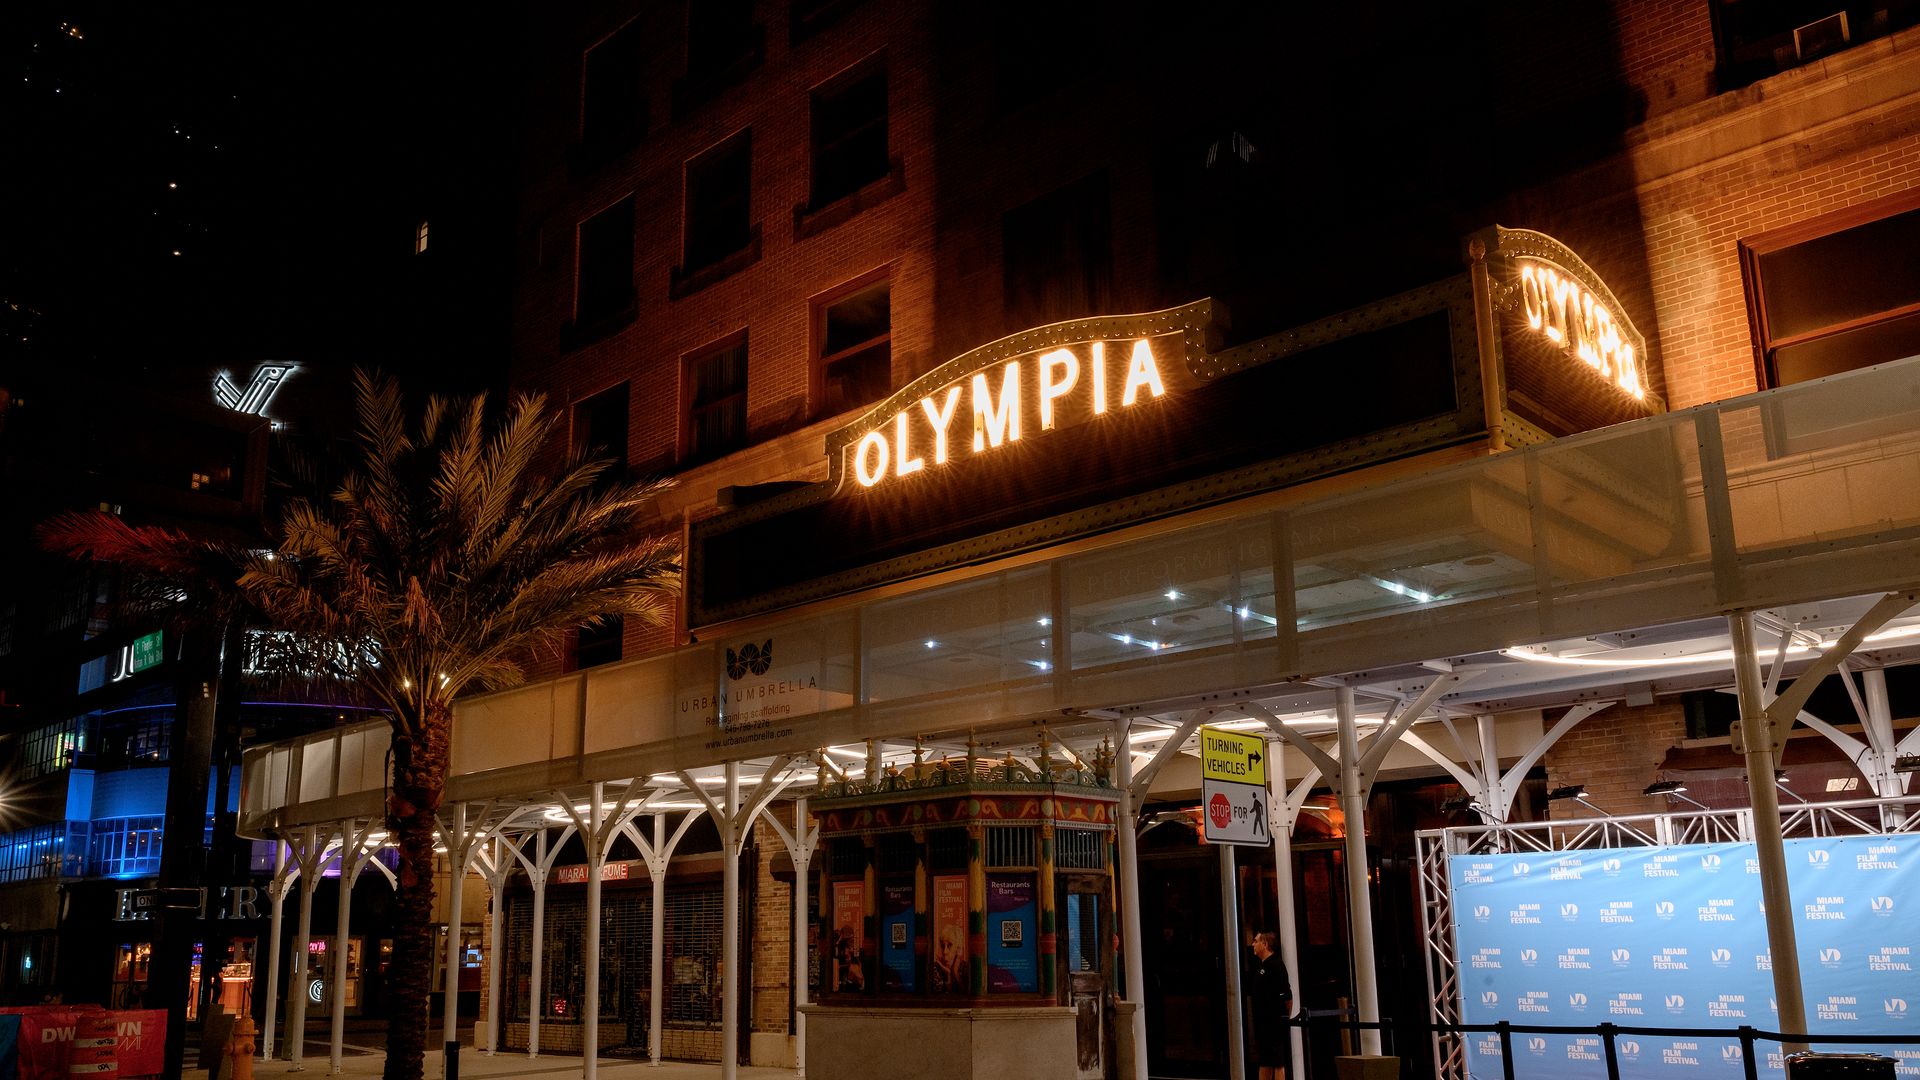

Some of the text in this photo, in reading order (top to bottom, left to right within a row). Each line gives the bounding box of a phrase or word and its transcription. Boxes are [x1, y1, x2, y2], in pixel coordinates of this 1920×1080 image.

[854, 338, 1166, 488] OLYMPIA
[681, 675, 817, 713] URBAN UMBRELLA
[751, 703, 791, 721] scaffolding
[705, 727, 793, 750] www.urbanumbrella.com
[1206, 737, 1244, 755] TURNING
[1206, 758, 1246, 776] VEHICLES
[1210, 804, 1248, 820] STOP FOR
[1869, 846, 1896, 854] MIAMI
[558, 867, 585, 881] MIARA
[991, 881, 1031, 889] Restaurants
[1819, 1012, 1858, 1020] FESTIVAL
